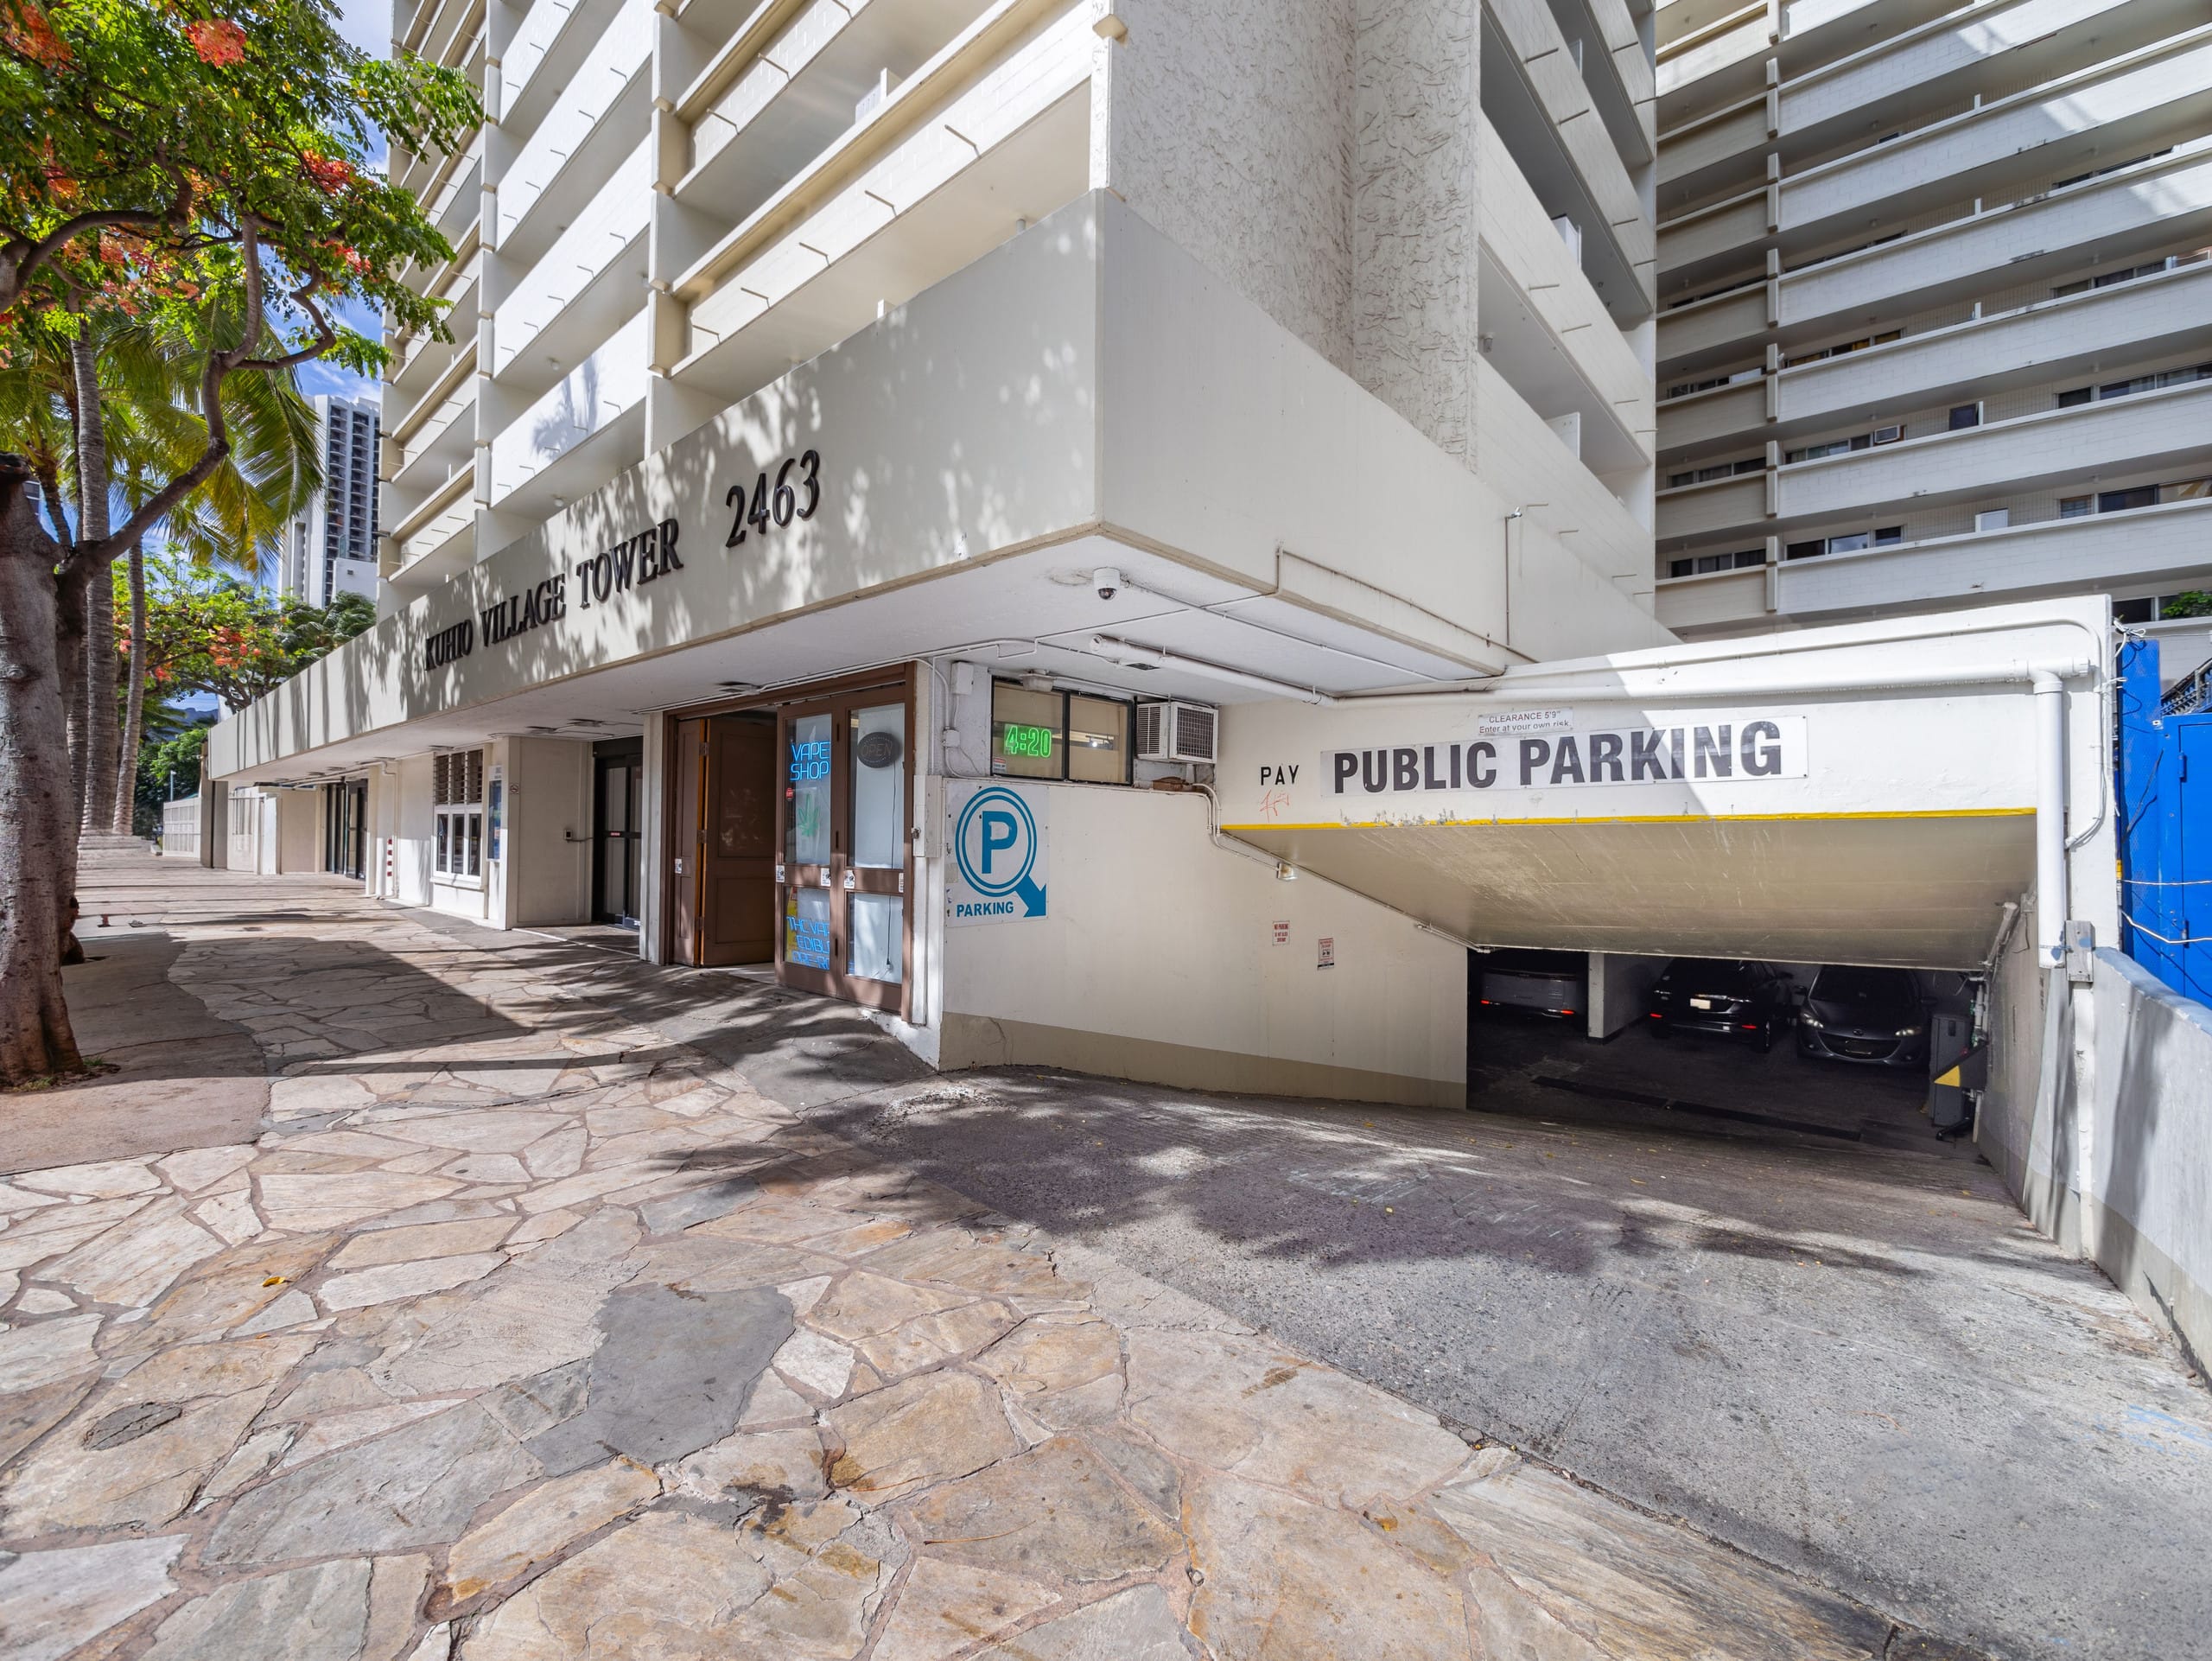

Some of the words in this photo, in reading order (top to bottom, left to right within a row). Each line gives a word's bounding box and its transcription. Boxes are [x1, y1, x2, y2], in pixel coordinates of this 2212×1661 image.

[725, 449, 821, 548] 2463
[424, 619, 474, 671] KUHIO
[480, 573, 567, 647] VILLAGE
[576, 518, 684, 609] TOWER
[1489, 712, 1542, 723] CLEARANCE
[1513, 723, 1531, 732] your
[791, 741, 831, 761] VAPE
[1005, 724, 1052, 758] 4:20
[1333, 741, 1497, 794] PUBLIC
[1518, 720, 1783, 786] PARKING
[790, 760, 830, 781] SHOP
[1260, 765, 1300, 786] PAY
[982, 811, 1018, 875] P
[957, 901, 1014, 918] PARKING
